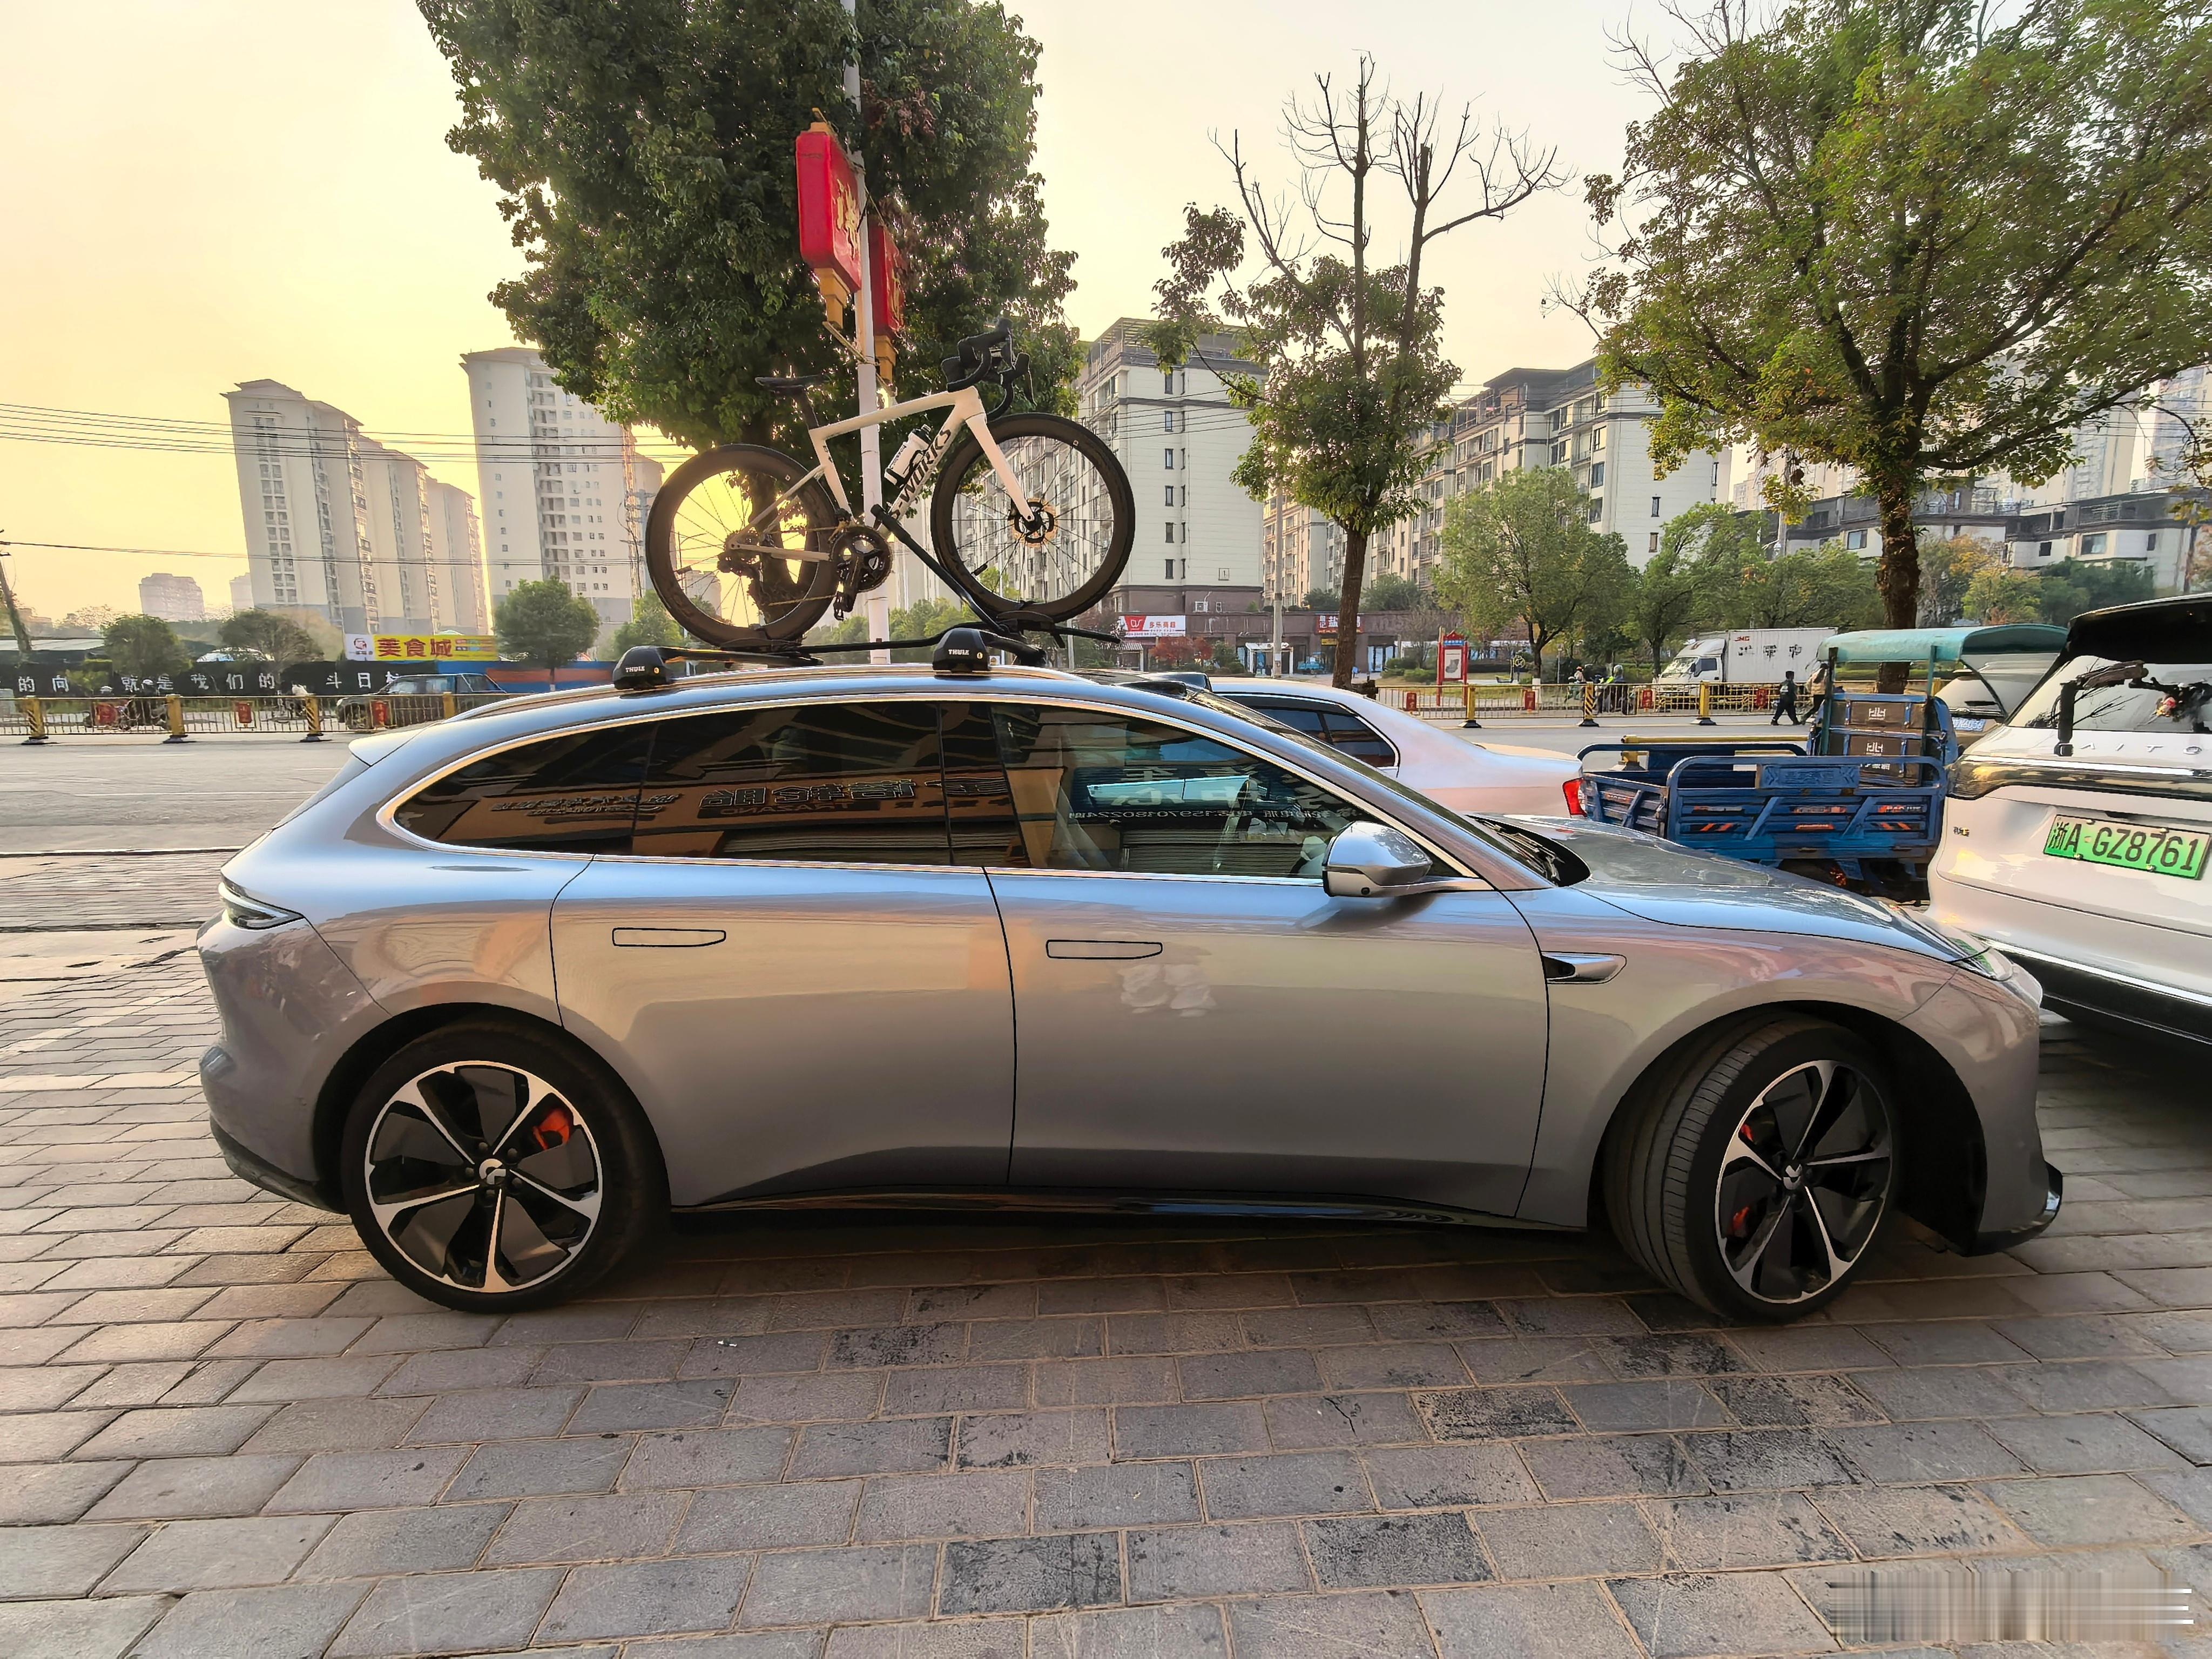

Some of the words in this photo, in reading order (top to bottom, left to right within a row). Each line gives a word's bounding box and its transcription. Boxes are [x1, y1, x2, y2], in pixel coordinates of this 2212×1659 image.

[376, 638, 453, 657] 美食城
[2080, 741, 2202, 754] AITO
